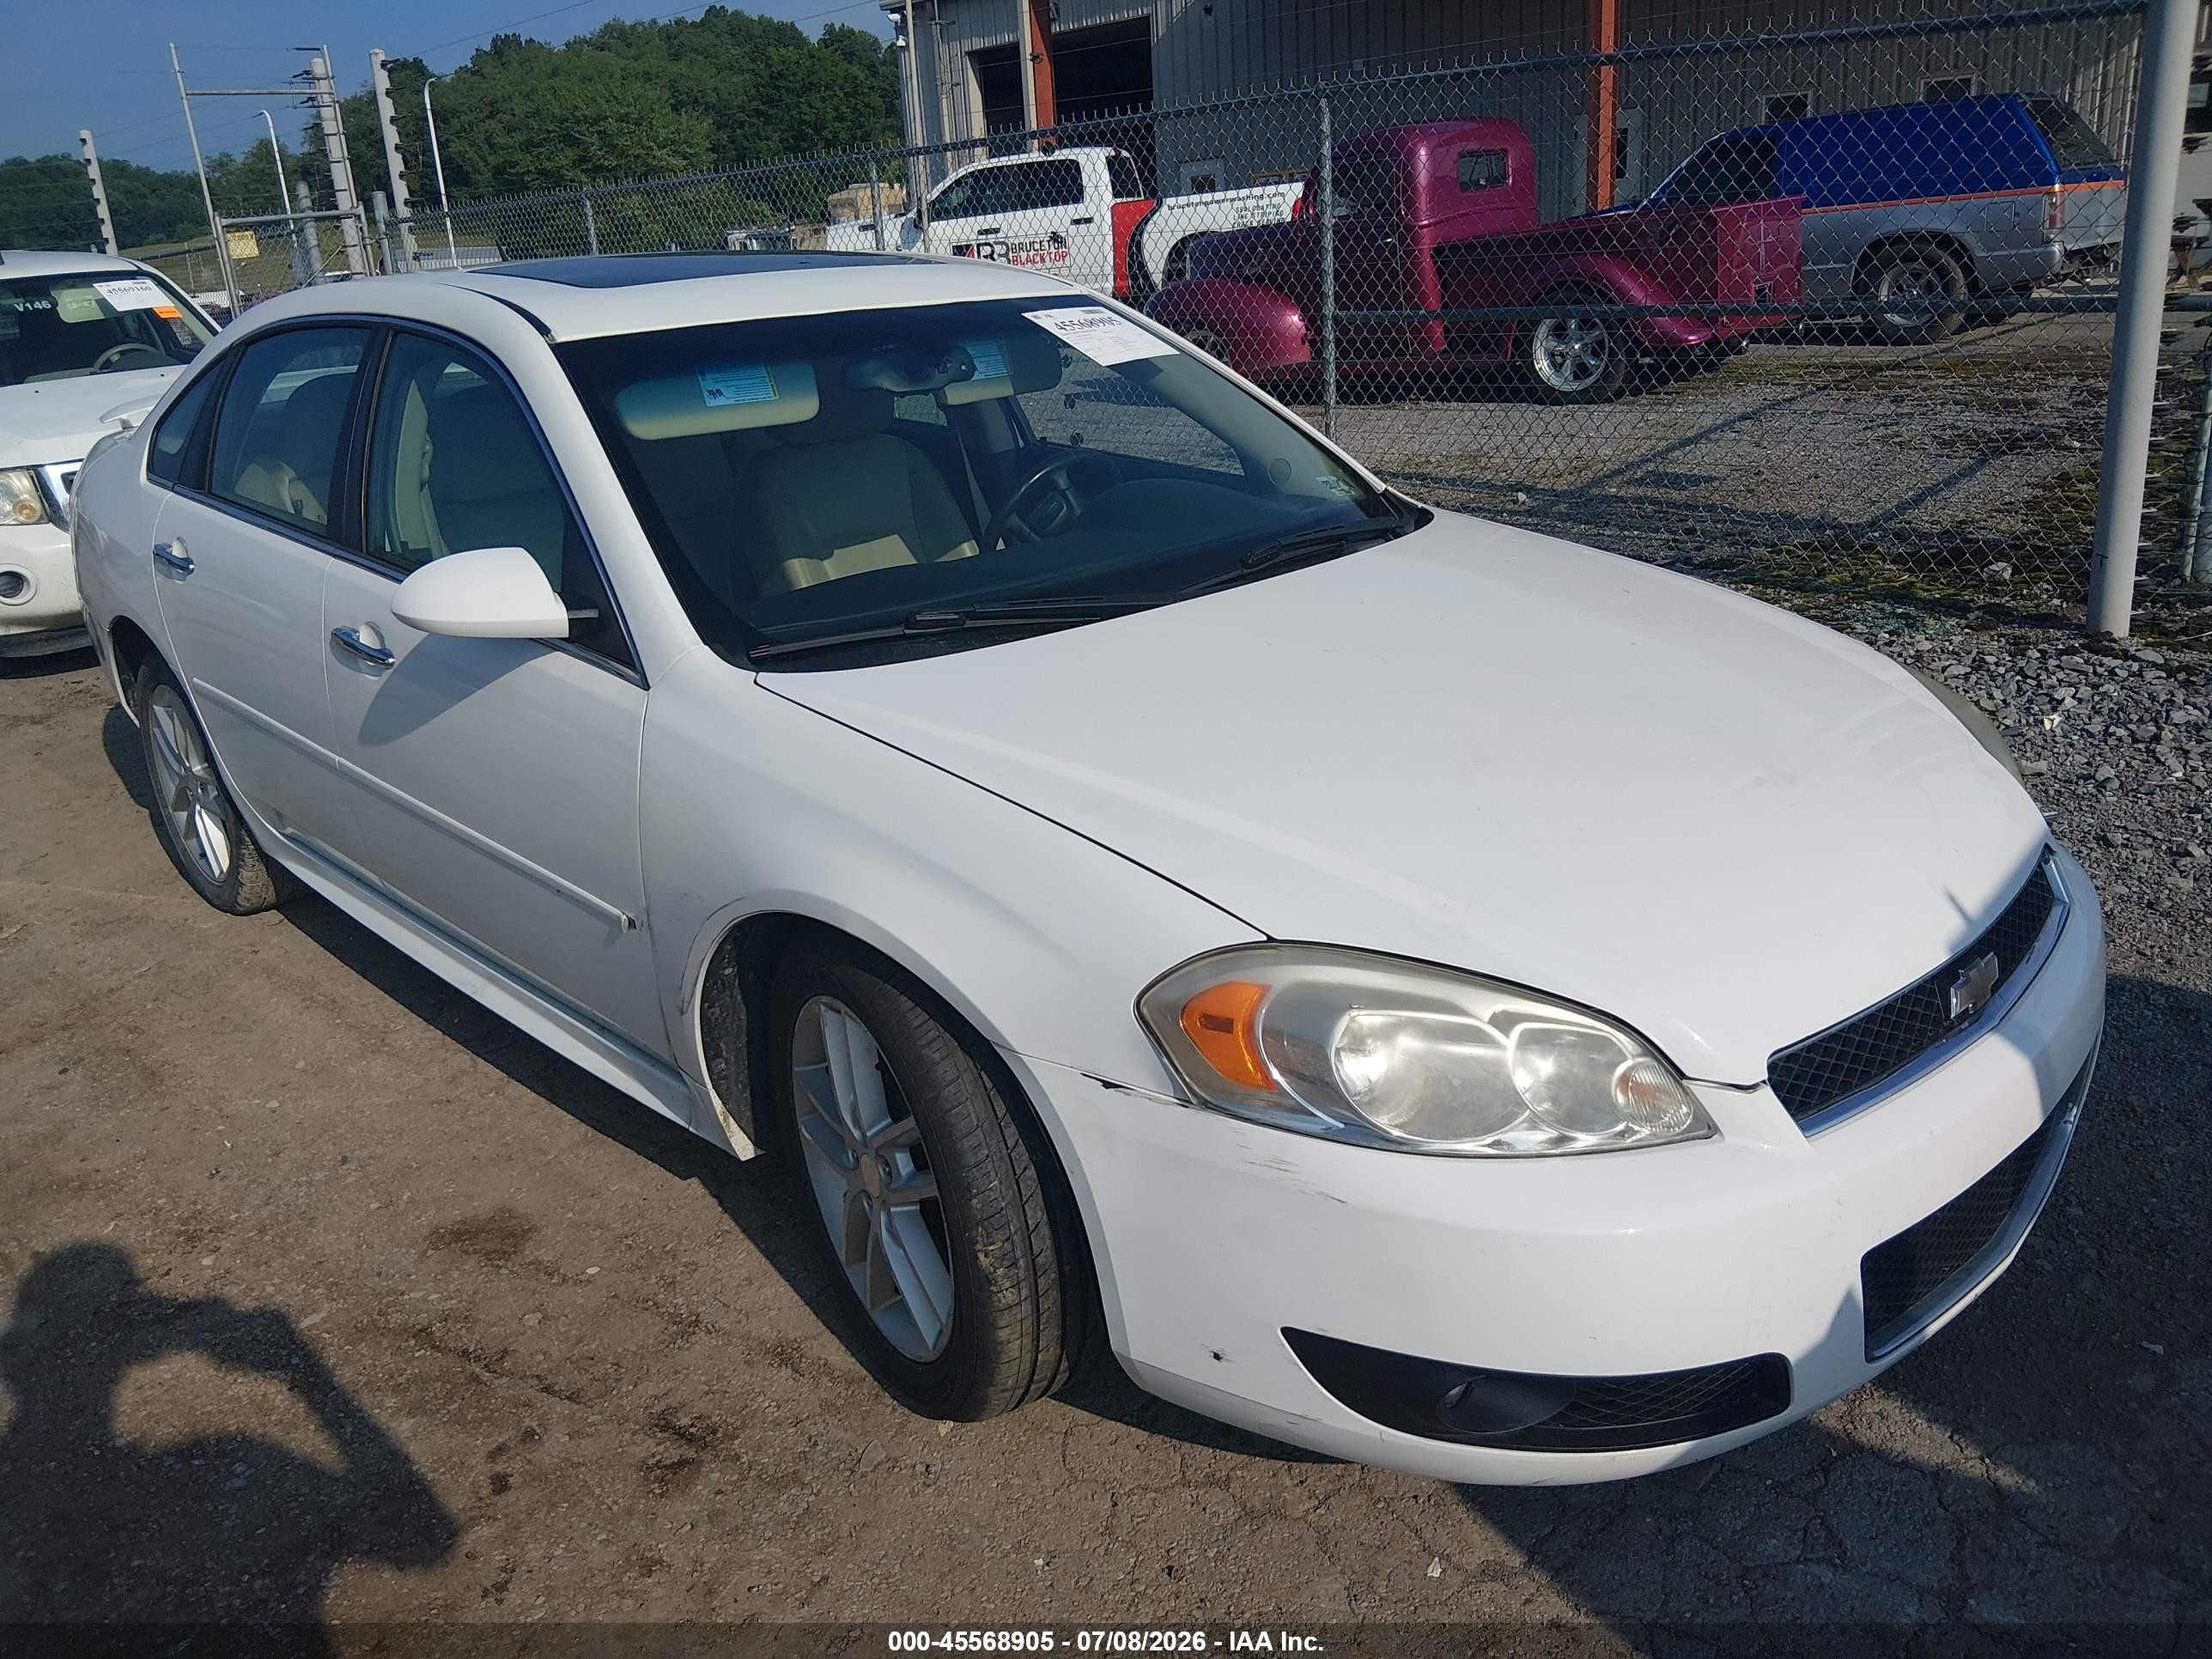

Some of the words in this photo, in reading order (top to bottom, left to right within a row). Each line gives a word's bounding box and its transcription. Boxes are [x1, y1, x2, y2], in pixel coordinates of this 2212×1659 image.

[1168, 191, 1285, 210] brucetonpowerwashing.com
[1011, 236, 1067, 254] BRUCETON
[14, 300, 52, 313] V146
[1054, 316, 1123, 332] 45568905
